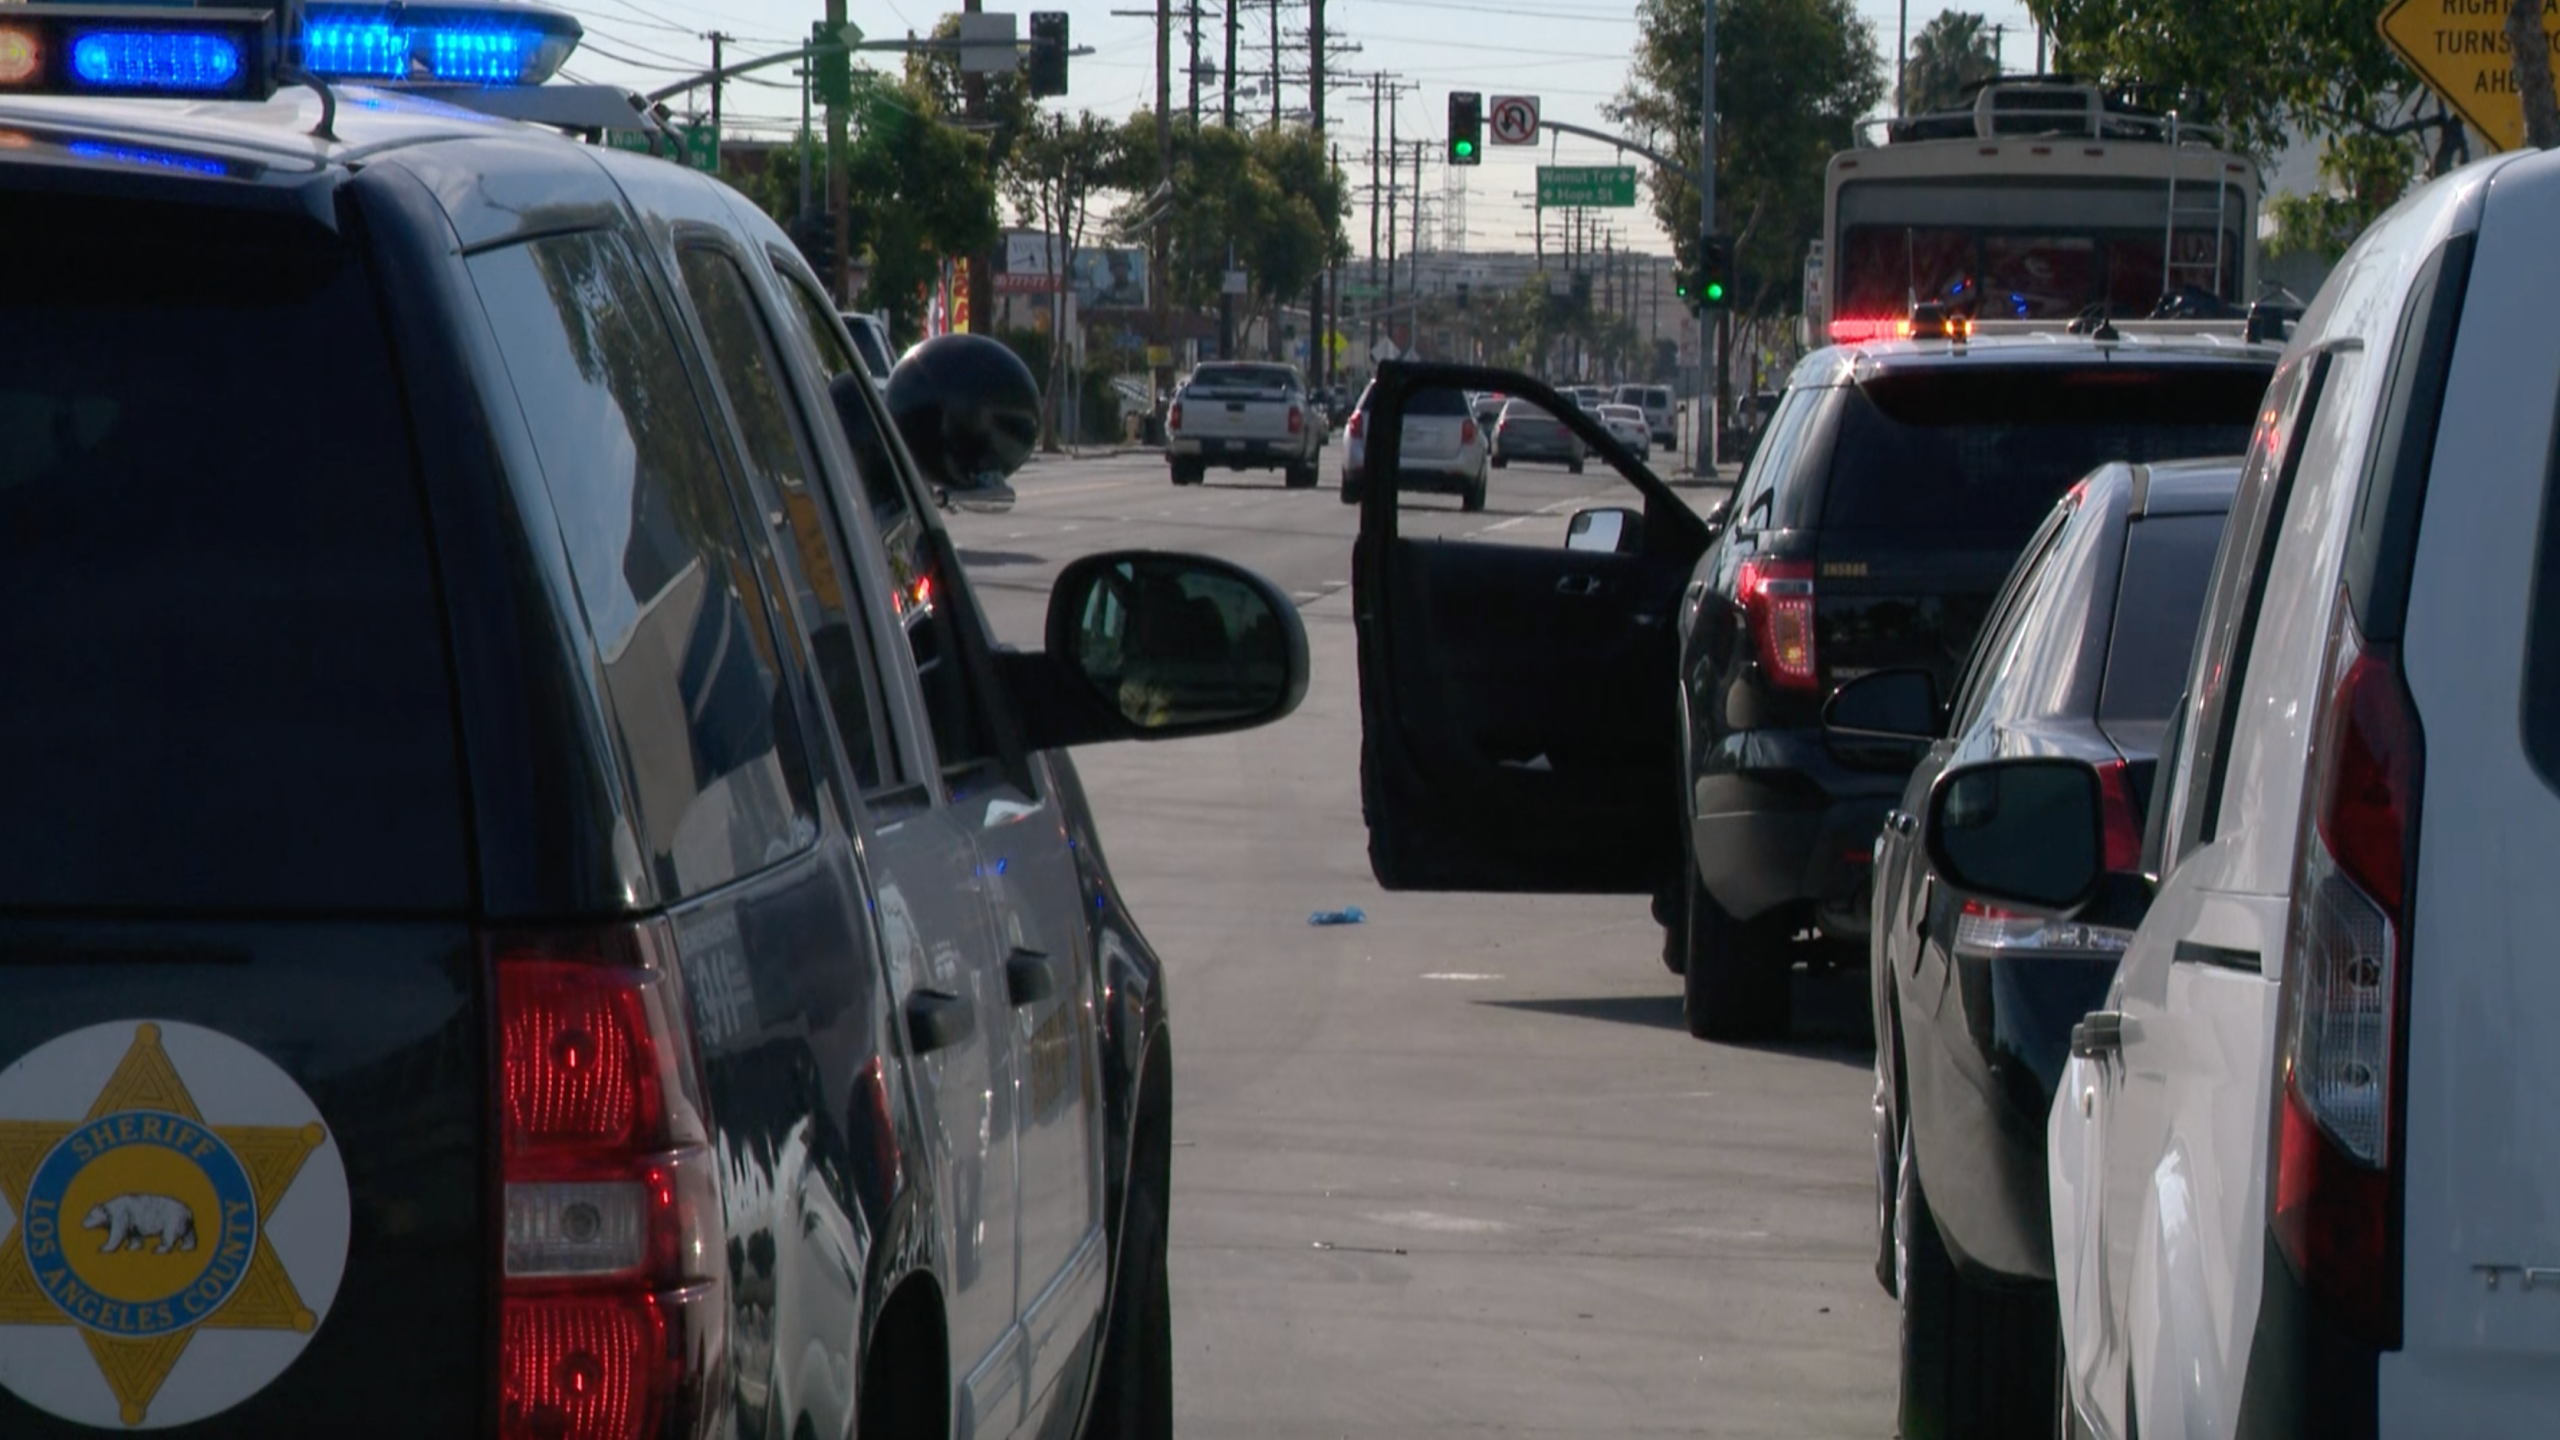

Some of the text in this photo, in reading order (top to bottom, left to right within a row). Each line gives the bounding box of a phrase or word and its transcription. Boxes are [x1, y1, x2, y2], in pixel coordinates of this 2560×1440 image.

[2434, 30, 2511, 54] TURNS
[1541, 170, 1614, 184] Walnut Ter
[1557, 188, 1613, 203] Hope St
[71, 1114, 217, 1162] SHERIFF
[29, 1194, 250, 1332] LOS ANGELES COUNTY
